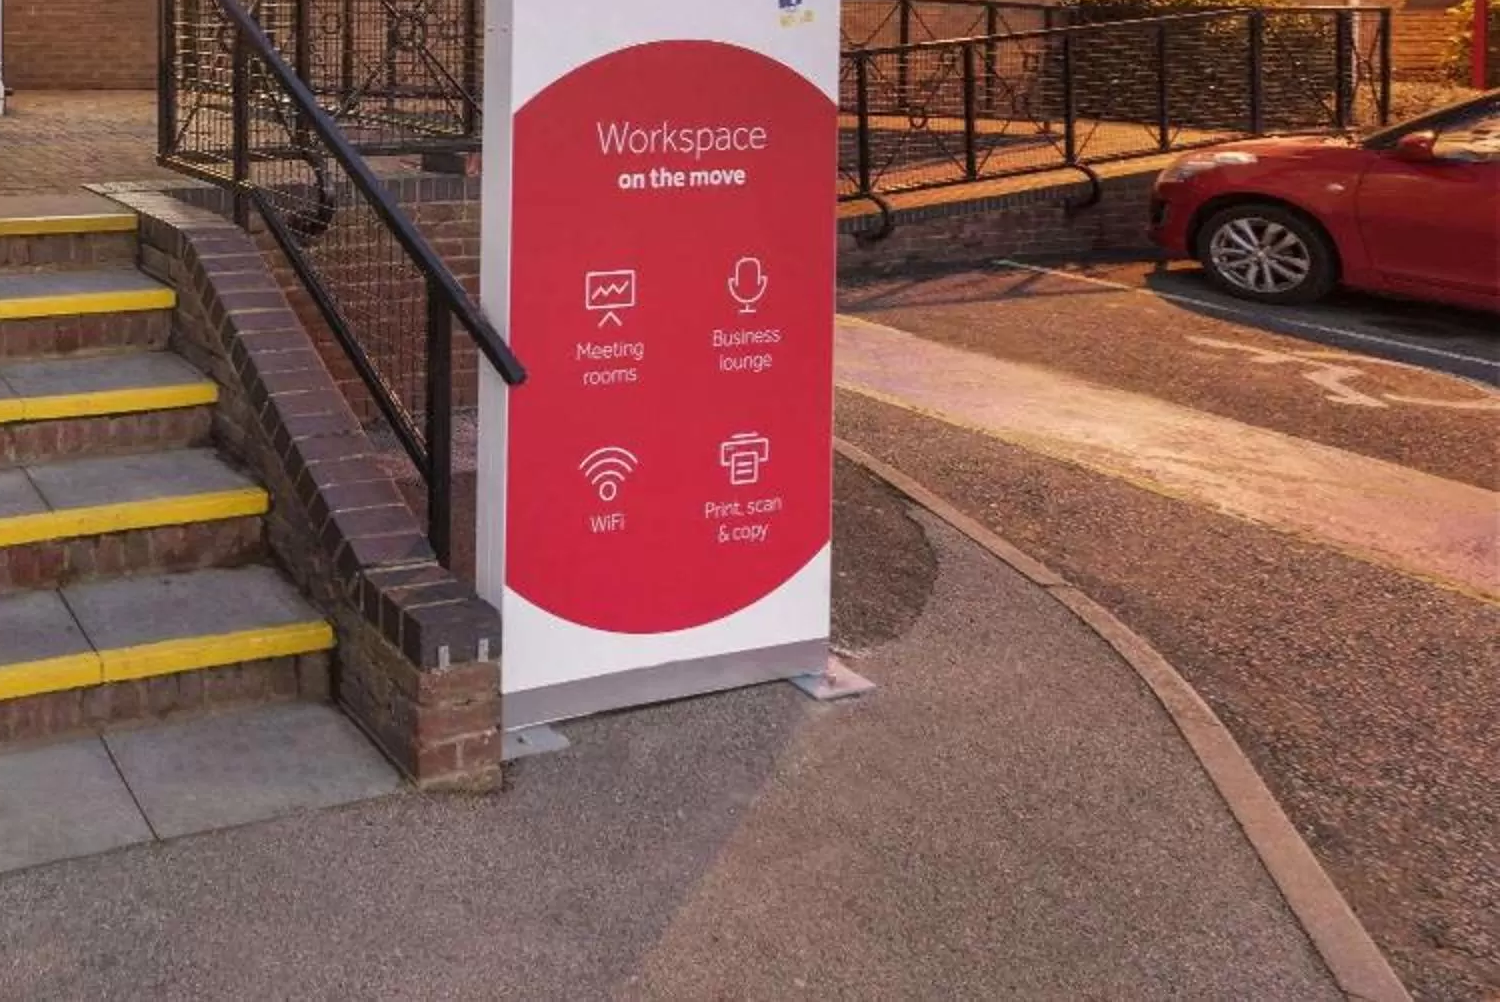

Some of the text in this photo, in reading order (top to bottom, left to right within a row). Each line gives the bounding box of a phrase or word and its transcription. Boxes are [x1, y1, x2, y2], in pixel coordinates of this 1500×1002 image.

[596, 120, 767, 160] Workspace
[617, 167, 746, 190] on the move
[711, 328, 782, 348] Business
[575, 341, 645, 362] Meeting
[718, 353, 773, 373] lounge
[582, 367, 638, 386] rooms
[746, 496, 784, 516] scan
[589, 512, 626, 534] WiFi
[717, 522, 769, 545] & copy
